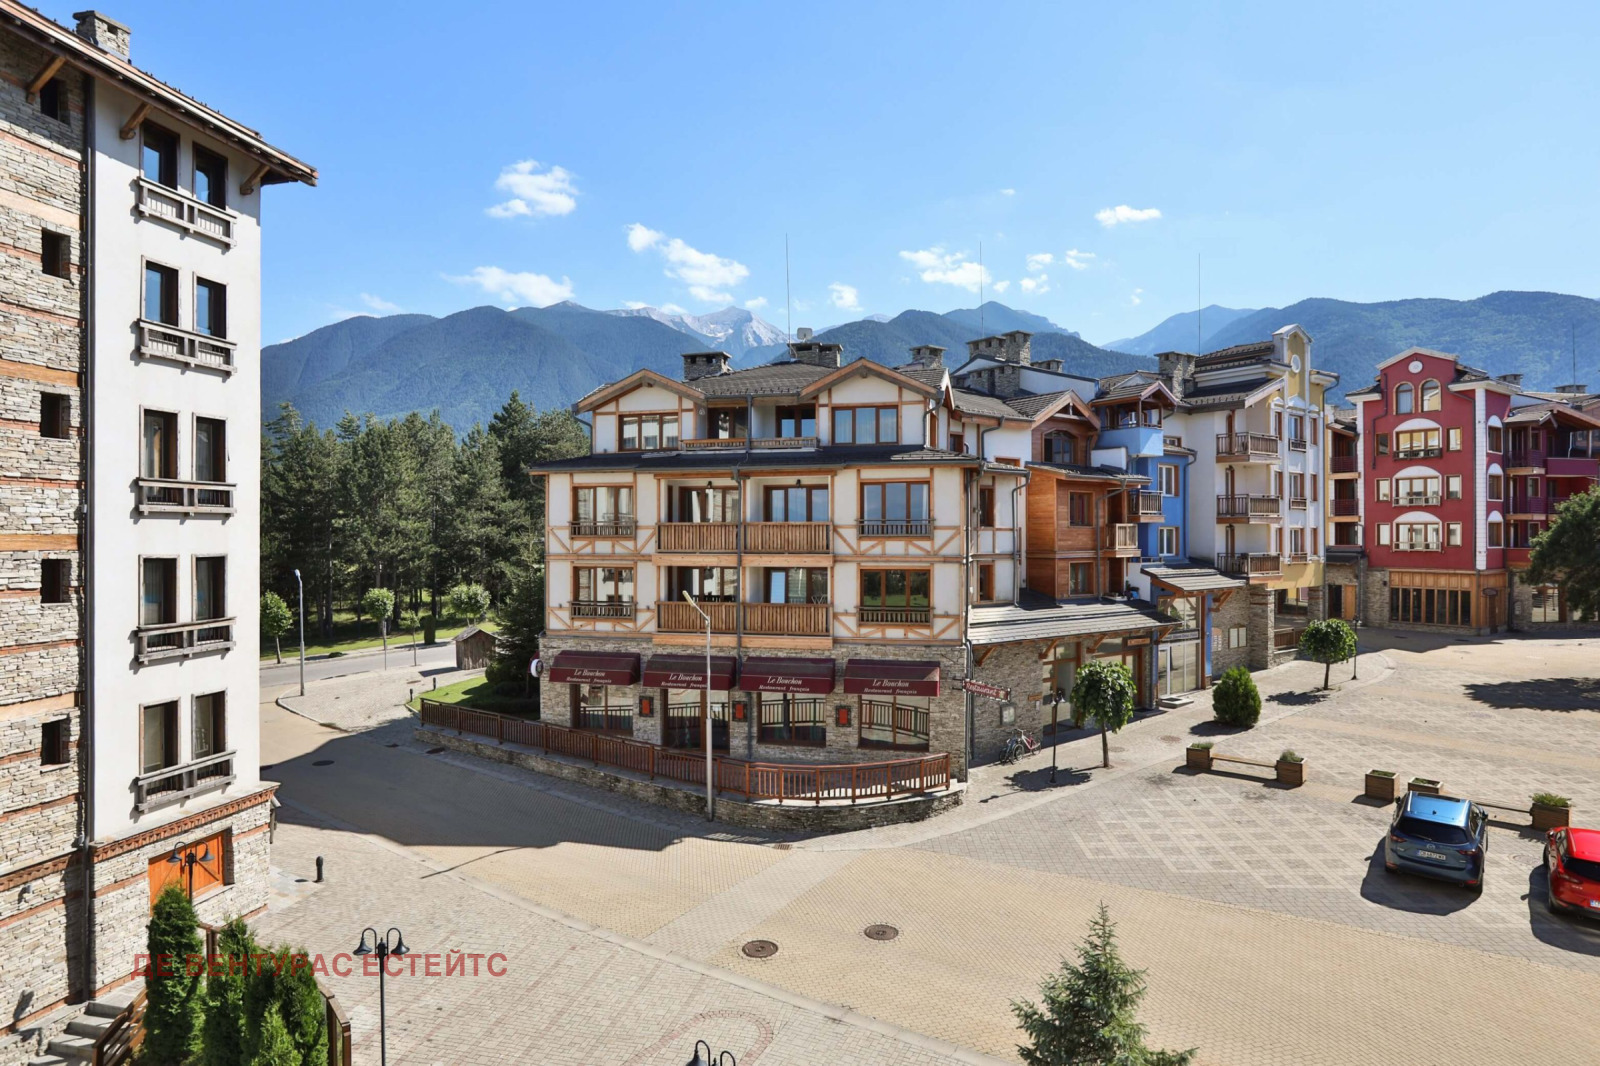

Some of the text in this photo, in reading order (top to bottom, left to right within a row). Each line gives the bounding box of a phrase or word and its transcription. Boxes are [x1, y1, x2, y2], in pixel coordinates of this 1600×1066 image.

[582, 669, 606, 677] Bouchon
[767, 676, 803, 685] Le Bouchon
[872, 679, 910, 687] Le Bouchon
[966, 683, 997, 696] Restaurant
